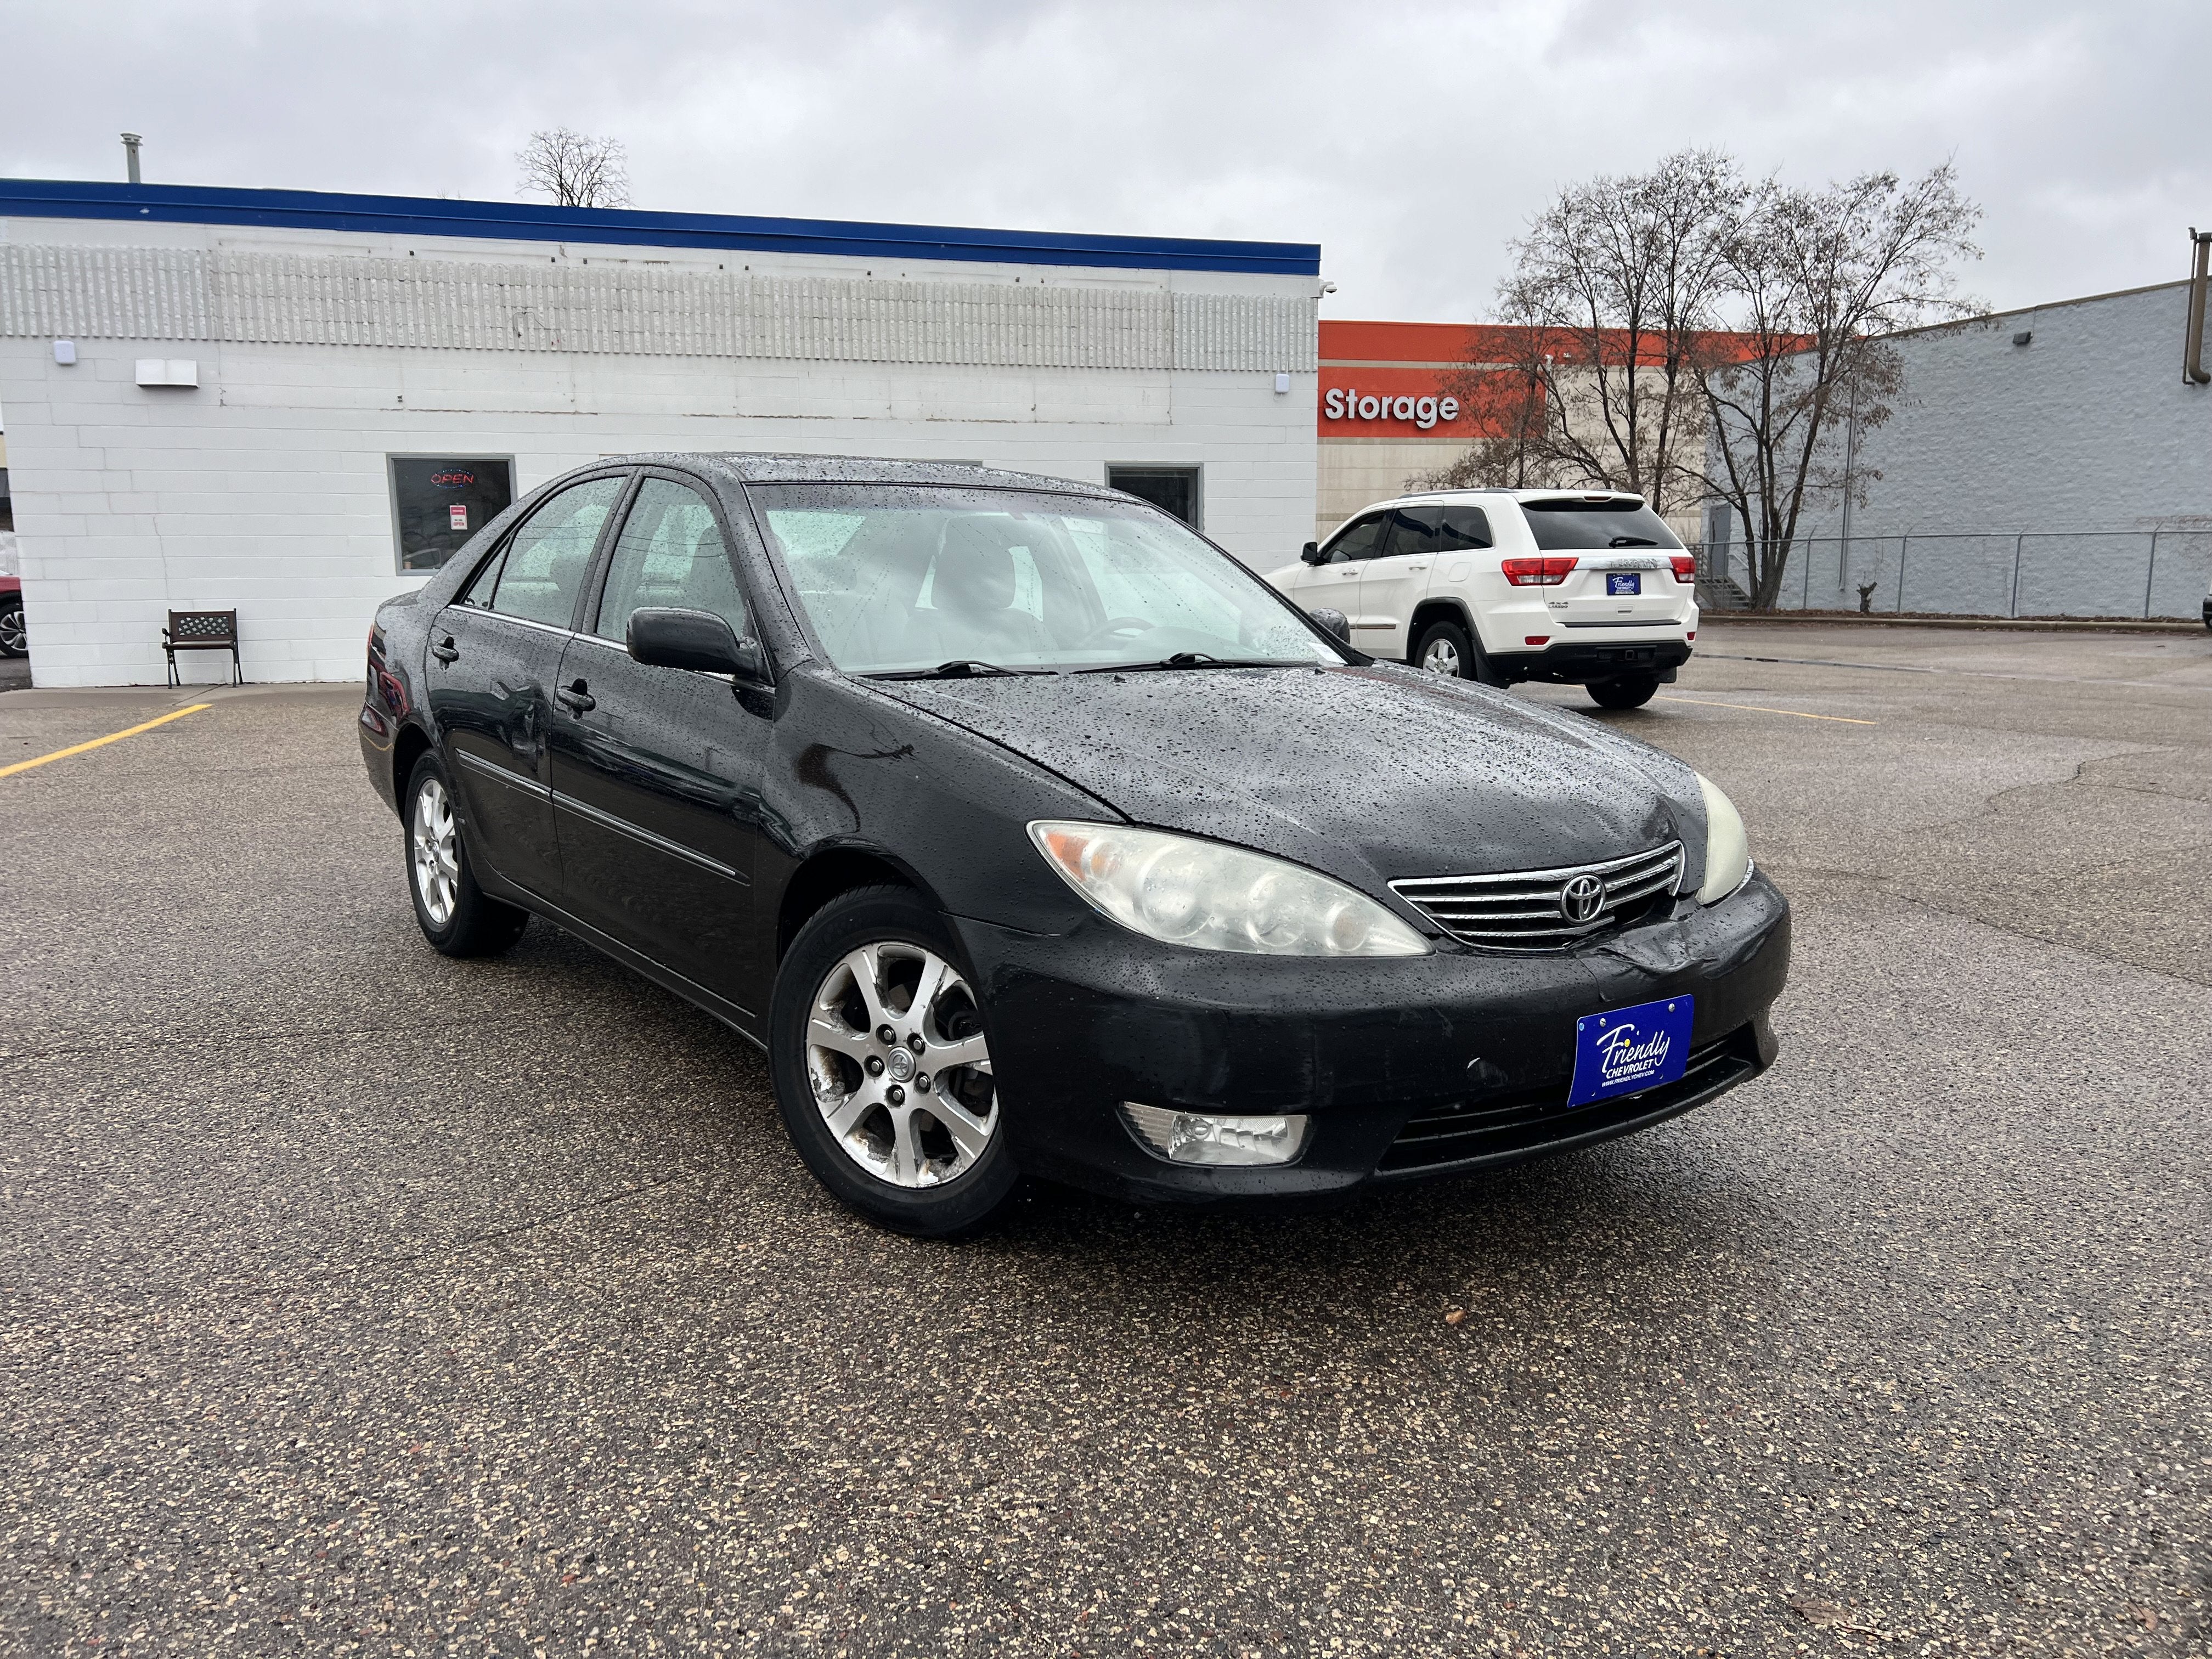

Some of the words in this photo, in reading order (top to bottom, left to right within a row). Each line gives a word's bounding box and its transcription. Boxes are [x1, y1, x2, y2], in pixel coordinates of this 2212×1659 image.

[1325, 388, 1459, 428] Storage
[431, 473, 474, 484] OPEN
[1612, 577, 1635, 589] Friendly
[1596, 1024, 1671, 1073] Friendly
[1601, 1069, 1655, 1087] WWW.FRIENDLYCHEV.COM
[1606, 1058, 1654, 1079] CHEVROLET
